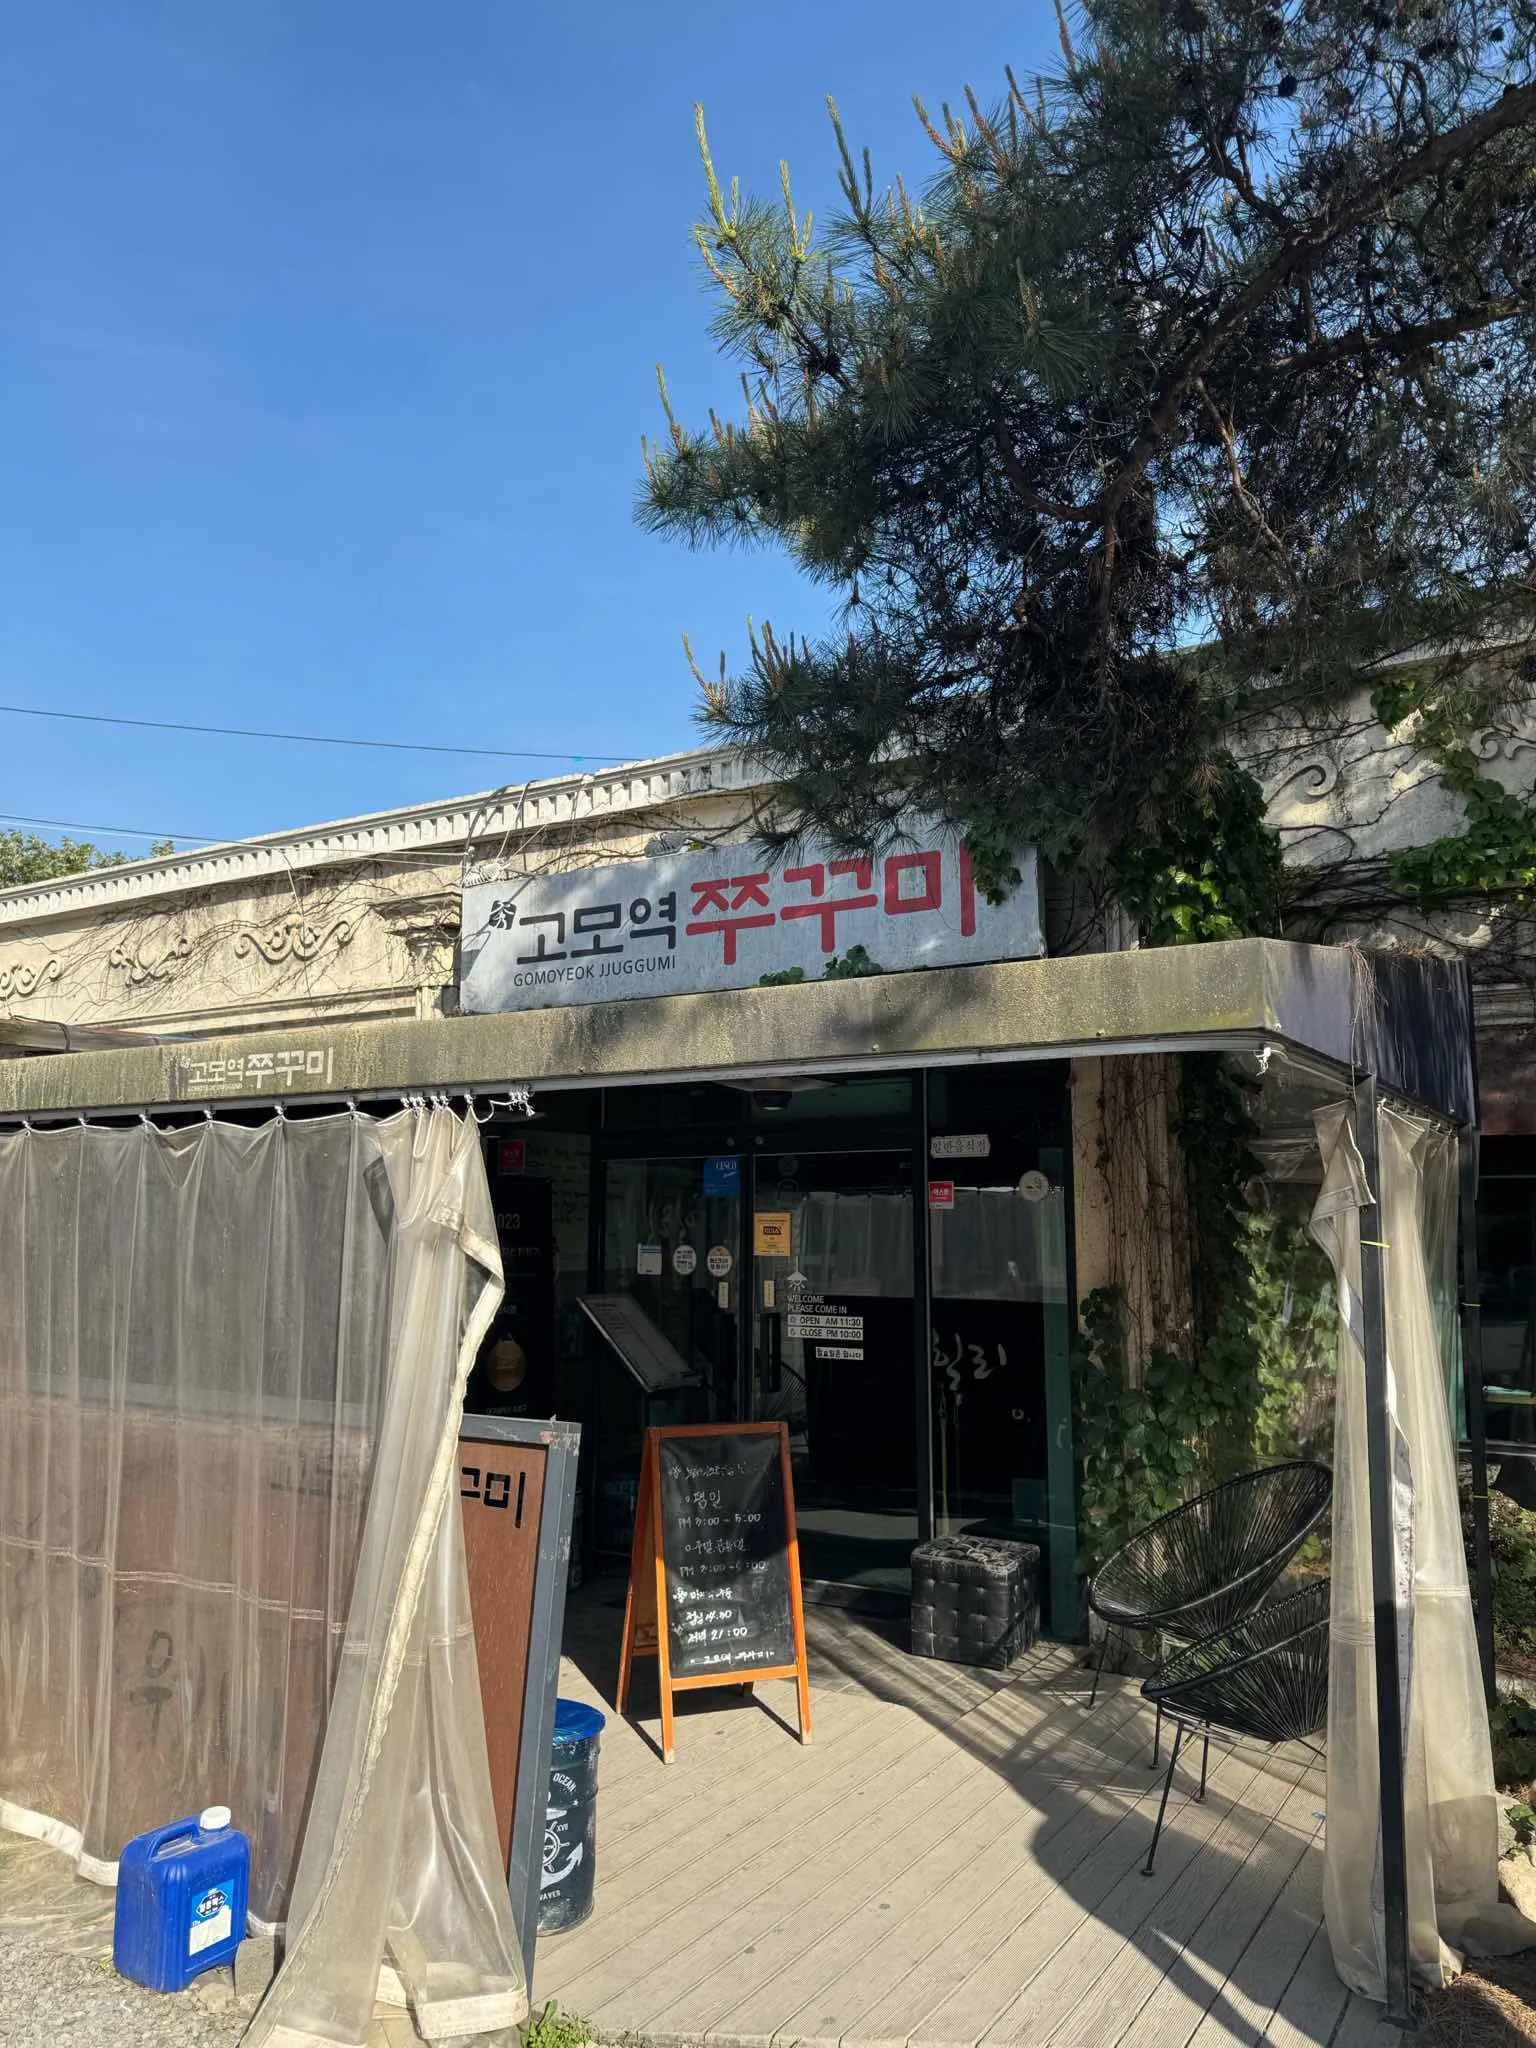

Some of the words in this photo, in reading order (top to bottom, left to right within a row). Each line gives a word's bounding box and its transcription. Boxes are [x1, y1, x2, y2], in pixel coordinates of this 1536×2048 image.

[517, 891, 676, 965] 고모역
[686, 839, 976, 966] 쭈꾸미
[513, 965, 596, 987] GOMOYEOK
[599, 954, 676, 981] JJUGGUMI
[189, 1057, 244, 1084] 고모역
[245, 1046, 334, 1089] 쭈꾸미
[787, 1295, 825, 1304] WELCOME
[787, 1304, 814, 1313] PLEASE
[815, 1304, 838, 1314] COME
[839, 1305, 848, 1314] IN
[799, 1317, 820, 1326] OPEN
[825, 1318, 838, 1326] AM
[839, 1317, 861, 1327] 11:30
[799, 1328, 823, 1337] CLOSE
[826, 1329, 838, 1338] PM
[839, 1329, 861, 1339] 10:00
[678, 1516, 692, 1529] PM
[734, 1513, 762, 1524] 5:00
[711, 1626, 748, 1641] 21:00
[552, 1772, 577, 1793] OCEAN
